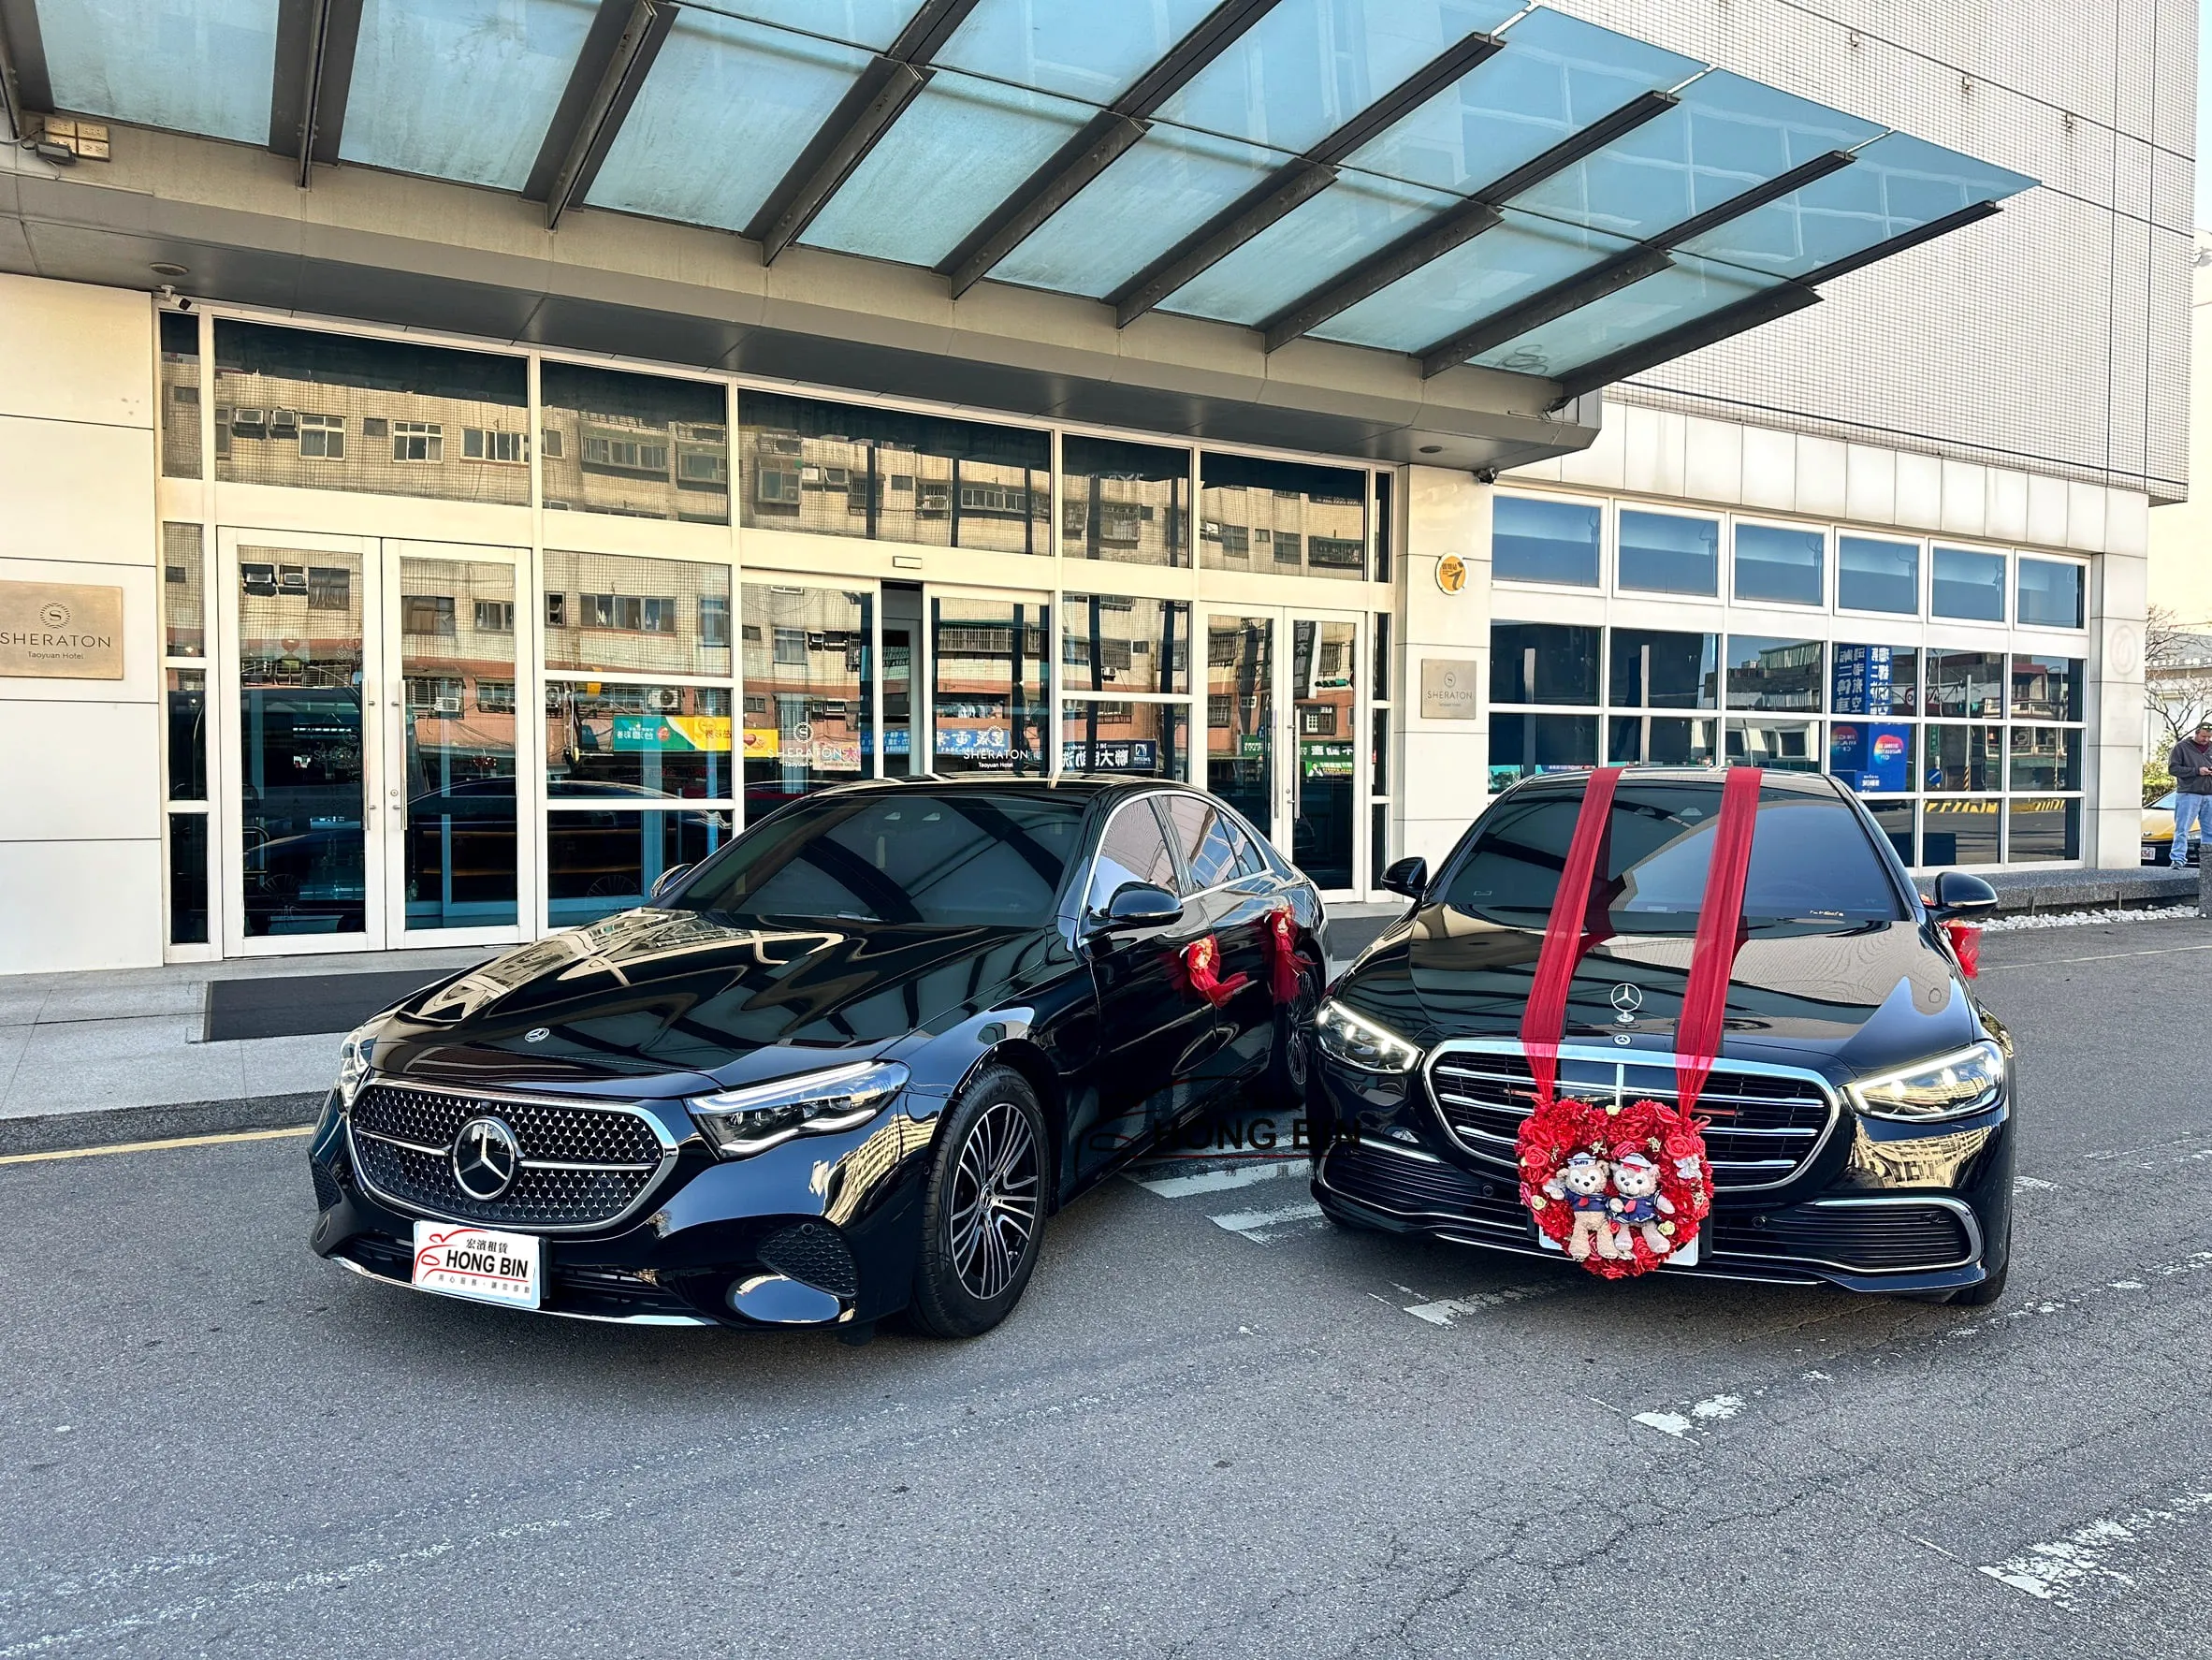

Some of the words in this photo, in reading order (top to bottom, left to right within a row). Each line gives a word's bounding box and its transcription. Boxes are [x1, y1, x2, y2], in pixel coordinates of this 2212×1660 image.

[0, 632, 111, 648] SHERATON
[28, 650, 61, 660] Taoyuan
[1427, 690, 1473, 700] SHERATON
[767, 748, 842, 759] SHERATON
[963, 750, 1028, 760] SHERATON
[446, 1249, 495, 1274] HONG
[499, 1257, 528, 1278] BIN
